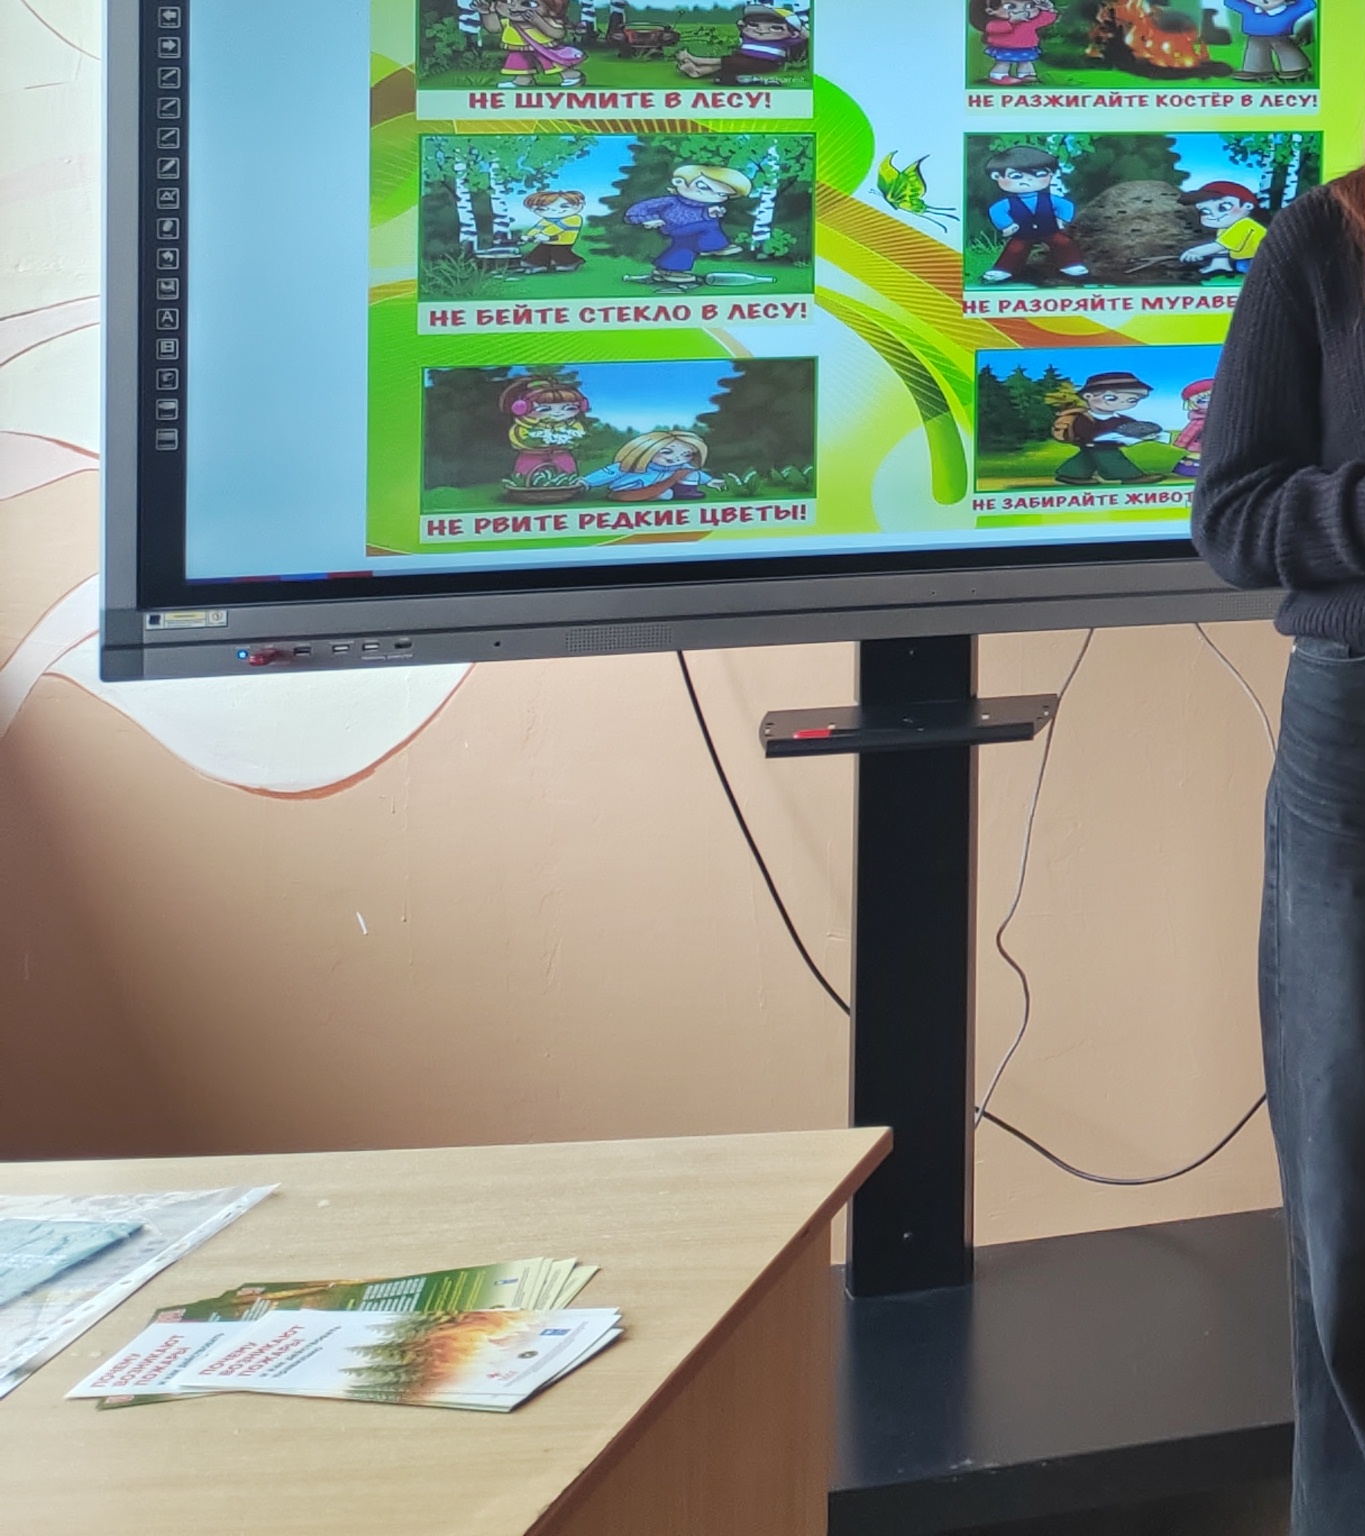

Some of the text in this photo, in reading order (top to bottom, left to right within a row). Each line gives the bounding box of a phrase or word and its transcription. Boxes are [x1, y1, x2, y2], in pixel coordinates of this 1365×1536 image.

[468, 92, 772, 110] НЕ ШУМИТЕ В ЛЕСУ!
[968, 91, 1318, 109] НЕ РАЗЖИГАЙТЕ КОСТЁР В ЛЕСУ!
[429, 302, 807, 327] НЕ БЕЙТЕ СТЕКЛО В ЛЕСУ!
[963, 300, 990, 313] НЕ
[997, 294, 1134, 313] РАЗОРЯЙТЕ
[973, 498, 996, 511] НЕ
[1003, 492, 1118, 510] ЗАБИРАЙТЕ
[427, 505, 807, 536] НЕ РВИТЕ РЕДКИЕ ЦВЕТЫ!
[112, 1335, 184, 1387] ВОЗНИКАЮТ
[134, 1347, 191, 1385] ПОЖАРЫ
[199, 1342, 257, 1375] ПОЧЕМУ
[219, 1325, 305, 1376] ВОЗНИКАЮТ
[239, 1338, 305, 1376] ПОЖАРЫ
[91, 1353, 142, 1388] ПОЧЕМУ
